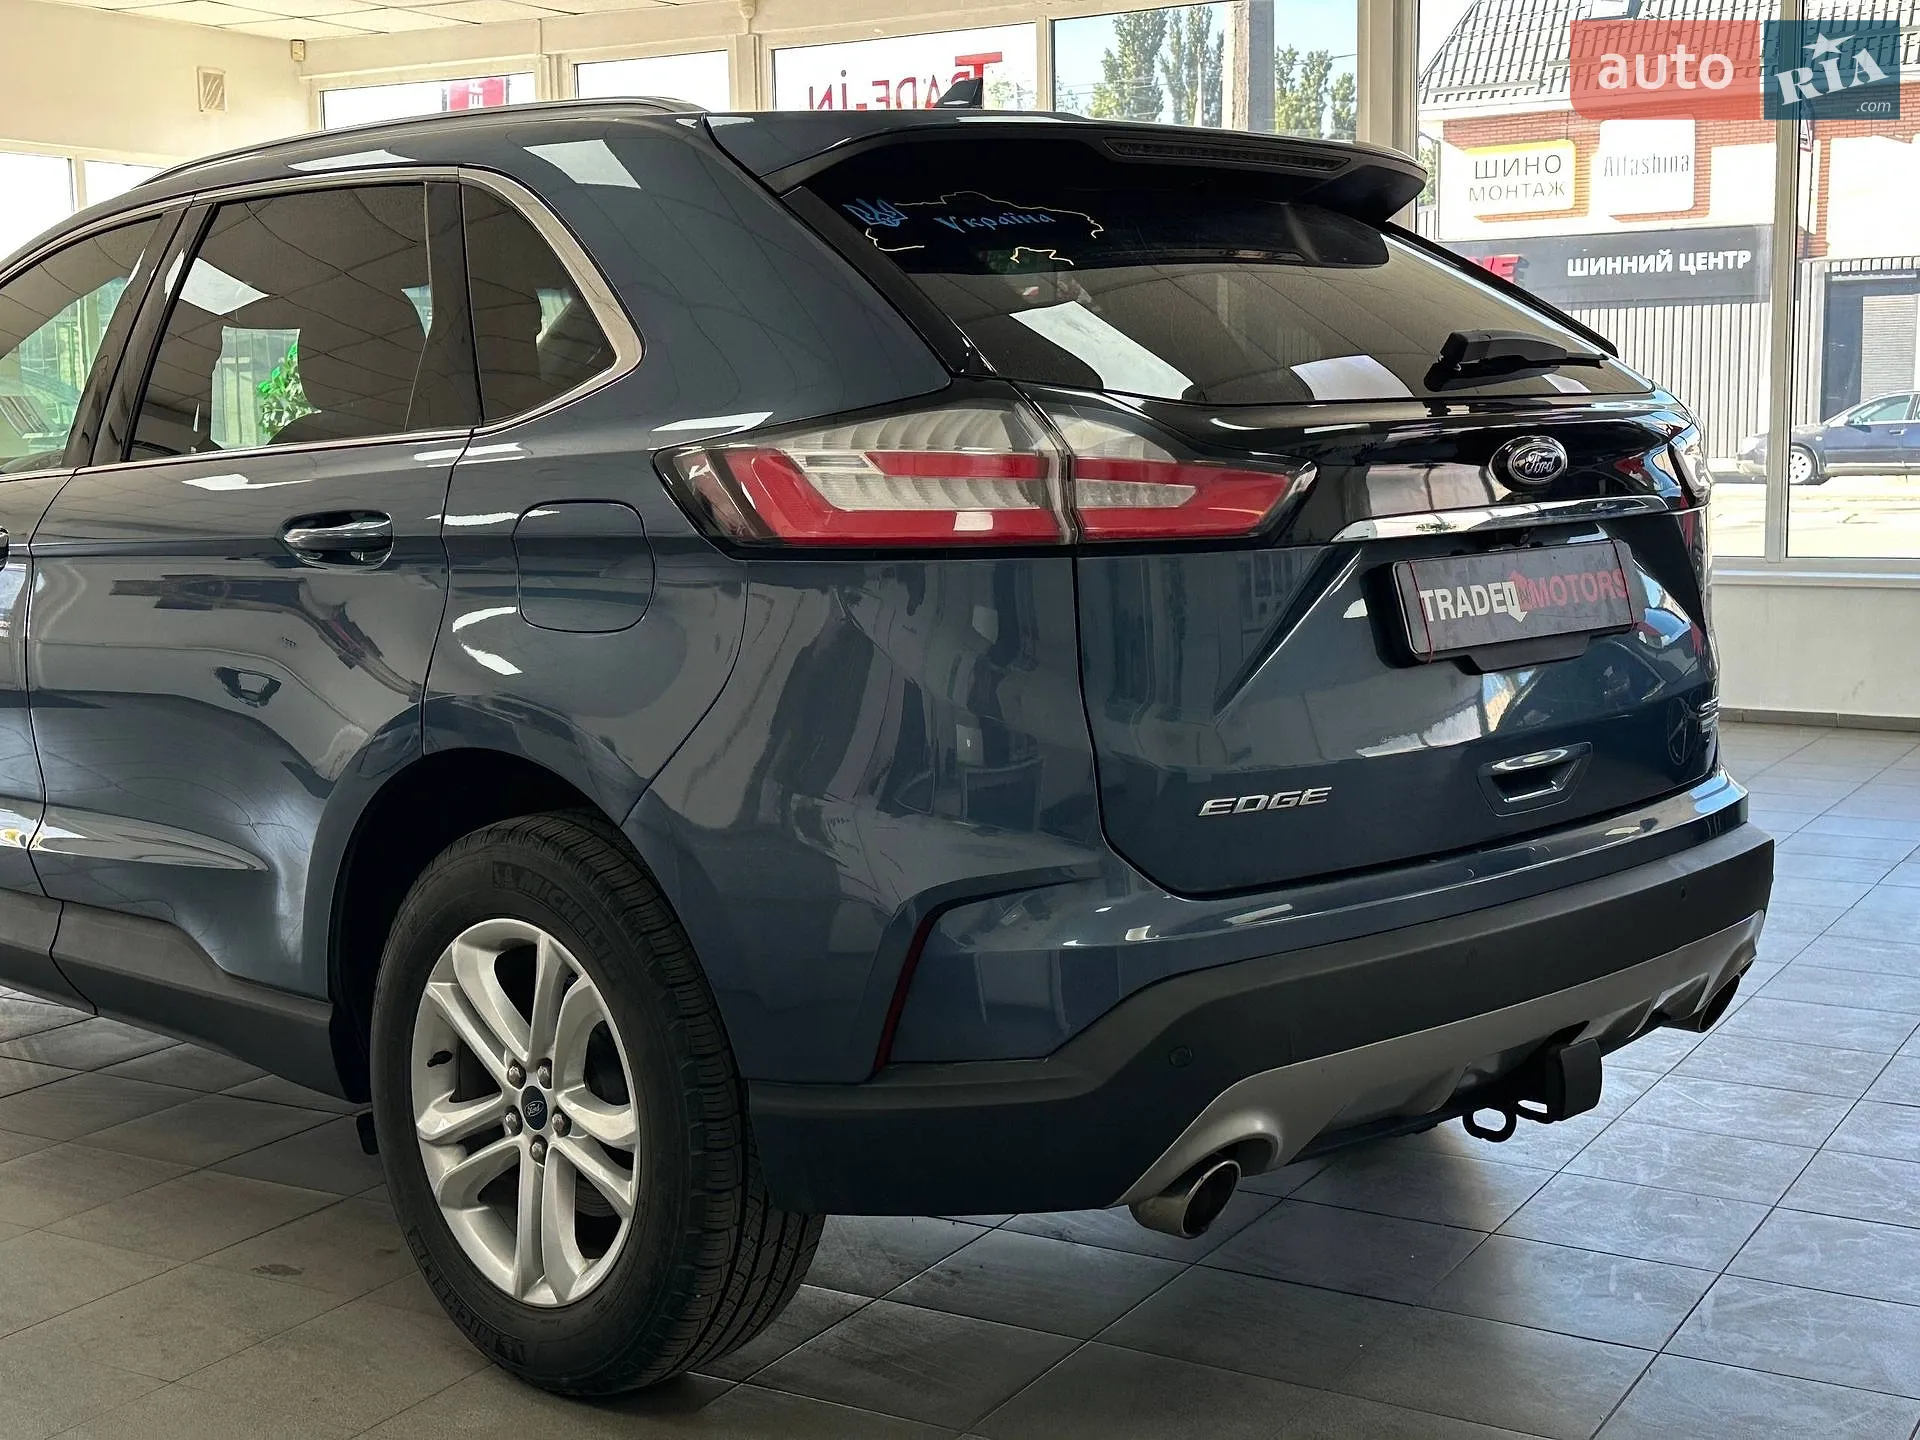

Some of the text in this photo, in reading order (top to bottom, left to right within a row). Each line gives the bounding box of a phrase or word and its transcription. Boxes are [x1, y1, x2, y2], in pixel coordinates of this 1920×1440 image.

[1474, 154, 1562, 180] ШИНО
[1468, 181, 1566, 202] МОНТАЖ
[932, 212, 1057, 234] Україна
[1567, 249, 1752, 277] ШИННИЙ ЦЕНТР
[1198, 786, 1333, 816] EDGE
